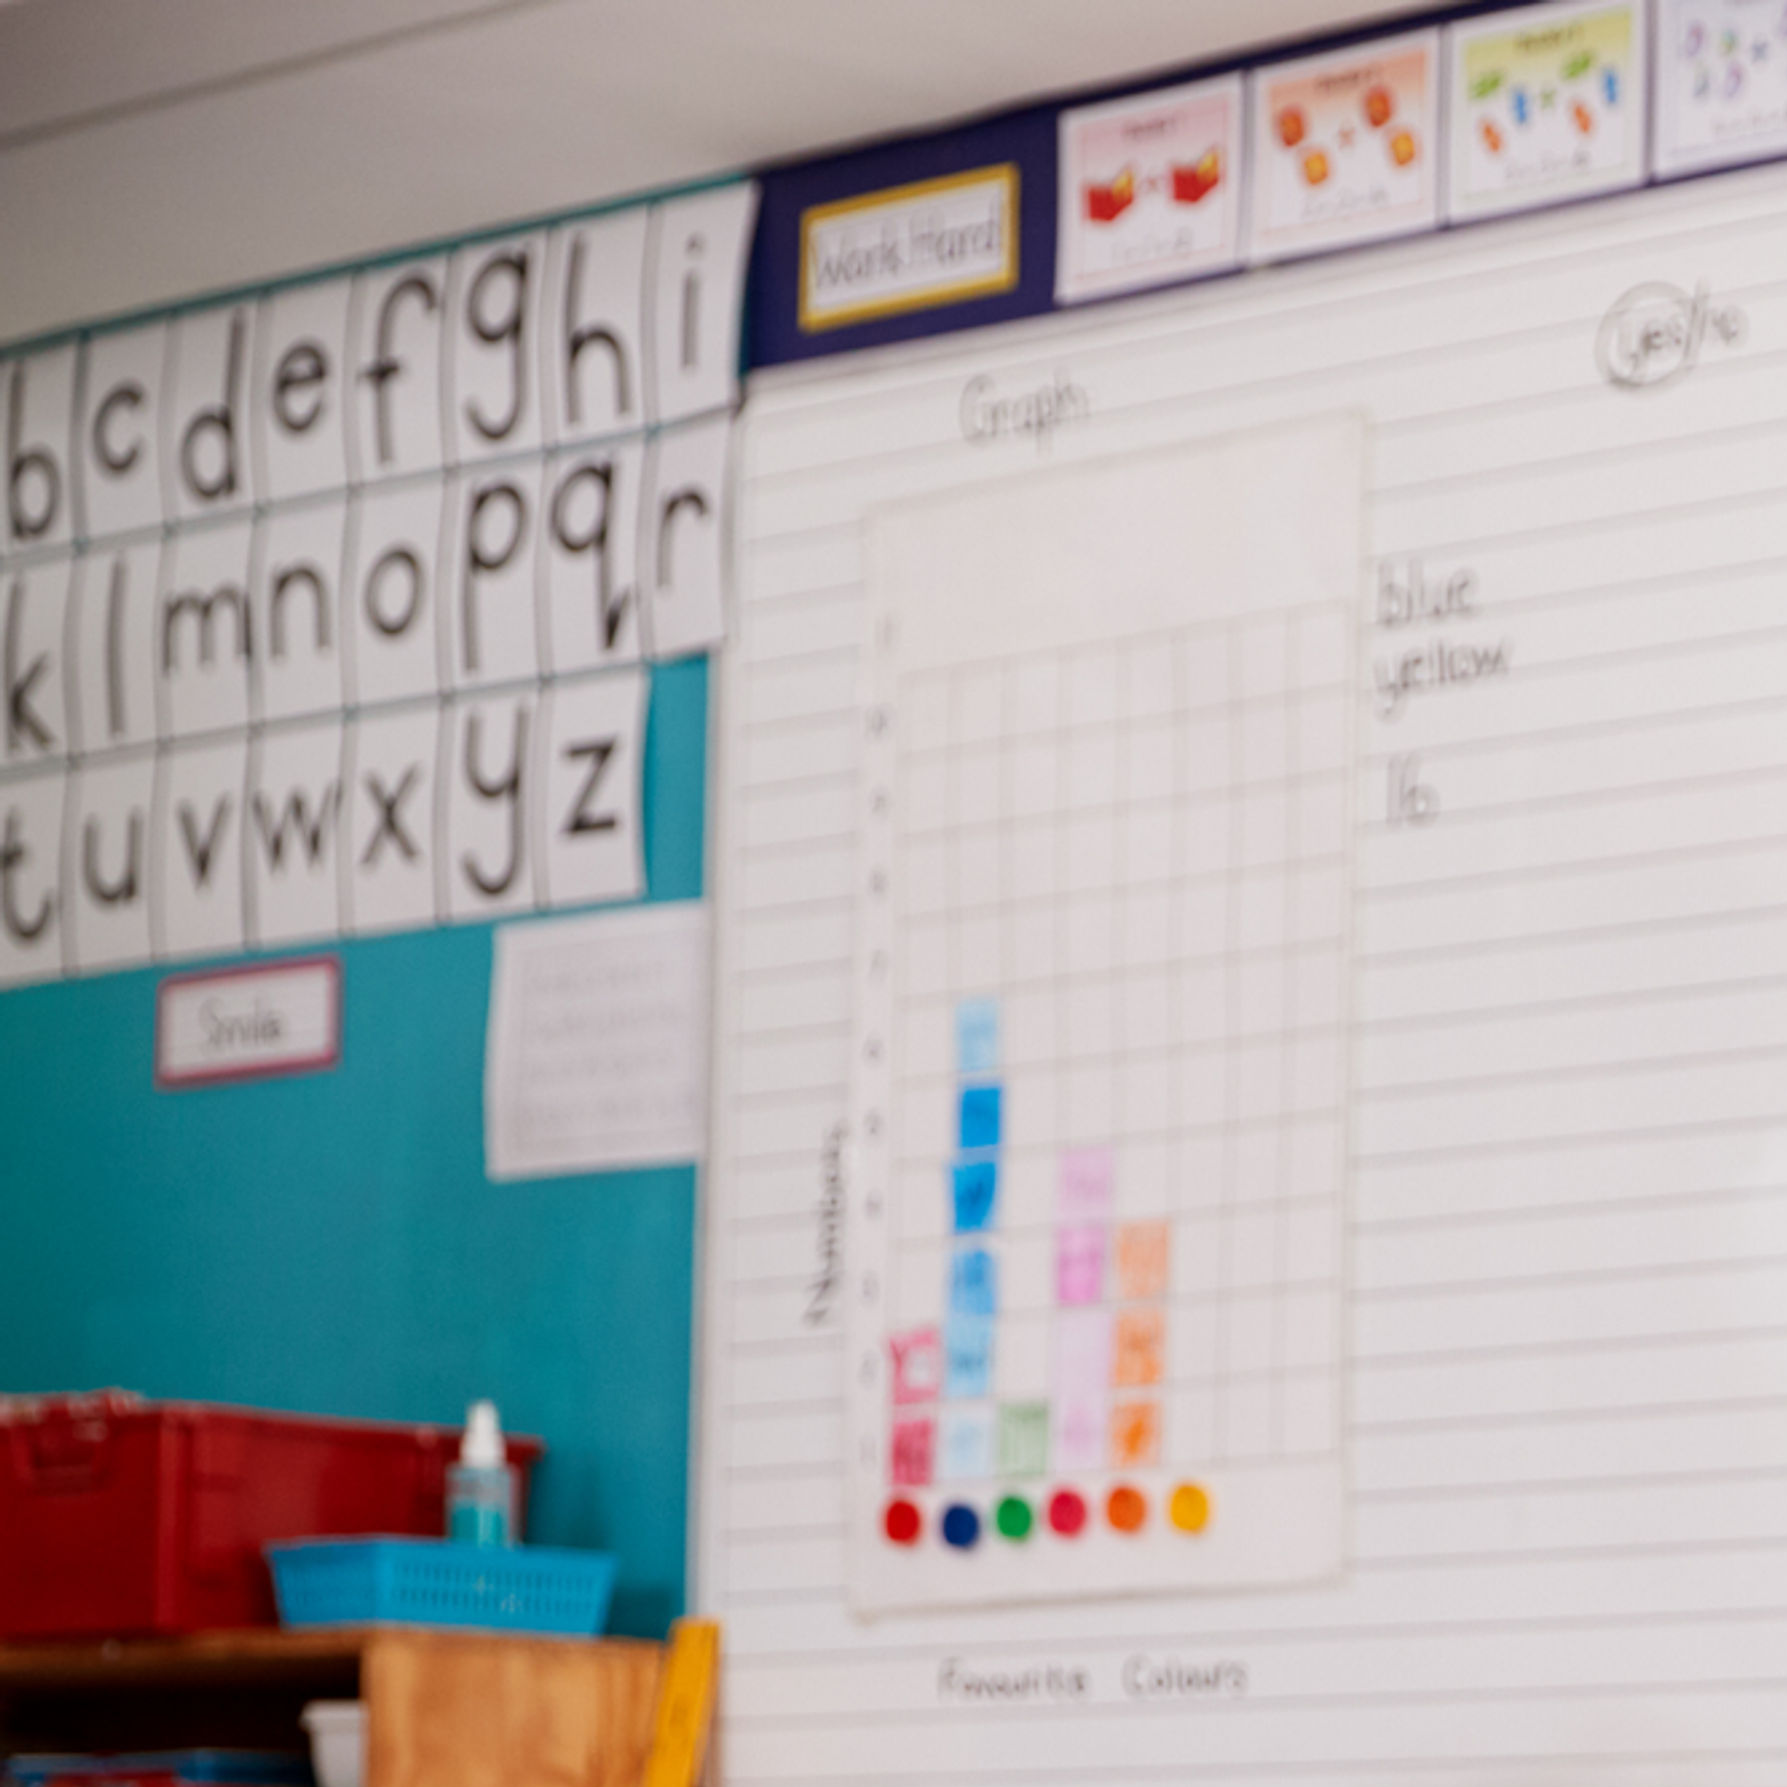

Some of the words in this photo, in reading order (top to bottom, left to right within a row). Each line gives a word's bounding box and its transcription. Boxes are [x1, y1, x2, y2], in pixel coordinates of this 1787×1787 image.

[8, 360, 62, 541] b
[91, 380, 148, 478] c
[178, 309, 245, 501] d
[272, 335, 331, 436] e
[356, 269, 444, 465] f
[463, 245, 534, 441] g
[565, 238, 637, 426] h
[681, 232, 708, 371] i
[3, 570, 57, 757] k
[159, 583, 254, 676] m
[269, 563, 333, 660] n
[361, 545, 428, 639] o
[463, 479, 529, 676] p
[653, 483, 712, 592] r
[82, 808, 146, 909] u
[174, 794, 234, 894] v
[251, 780, 347, 880] w
[359, 762, 428, 869] x
[460, 702, 532, 899] y
[561, 736, 622, 842] z
